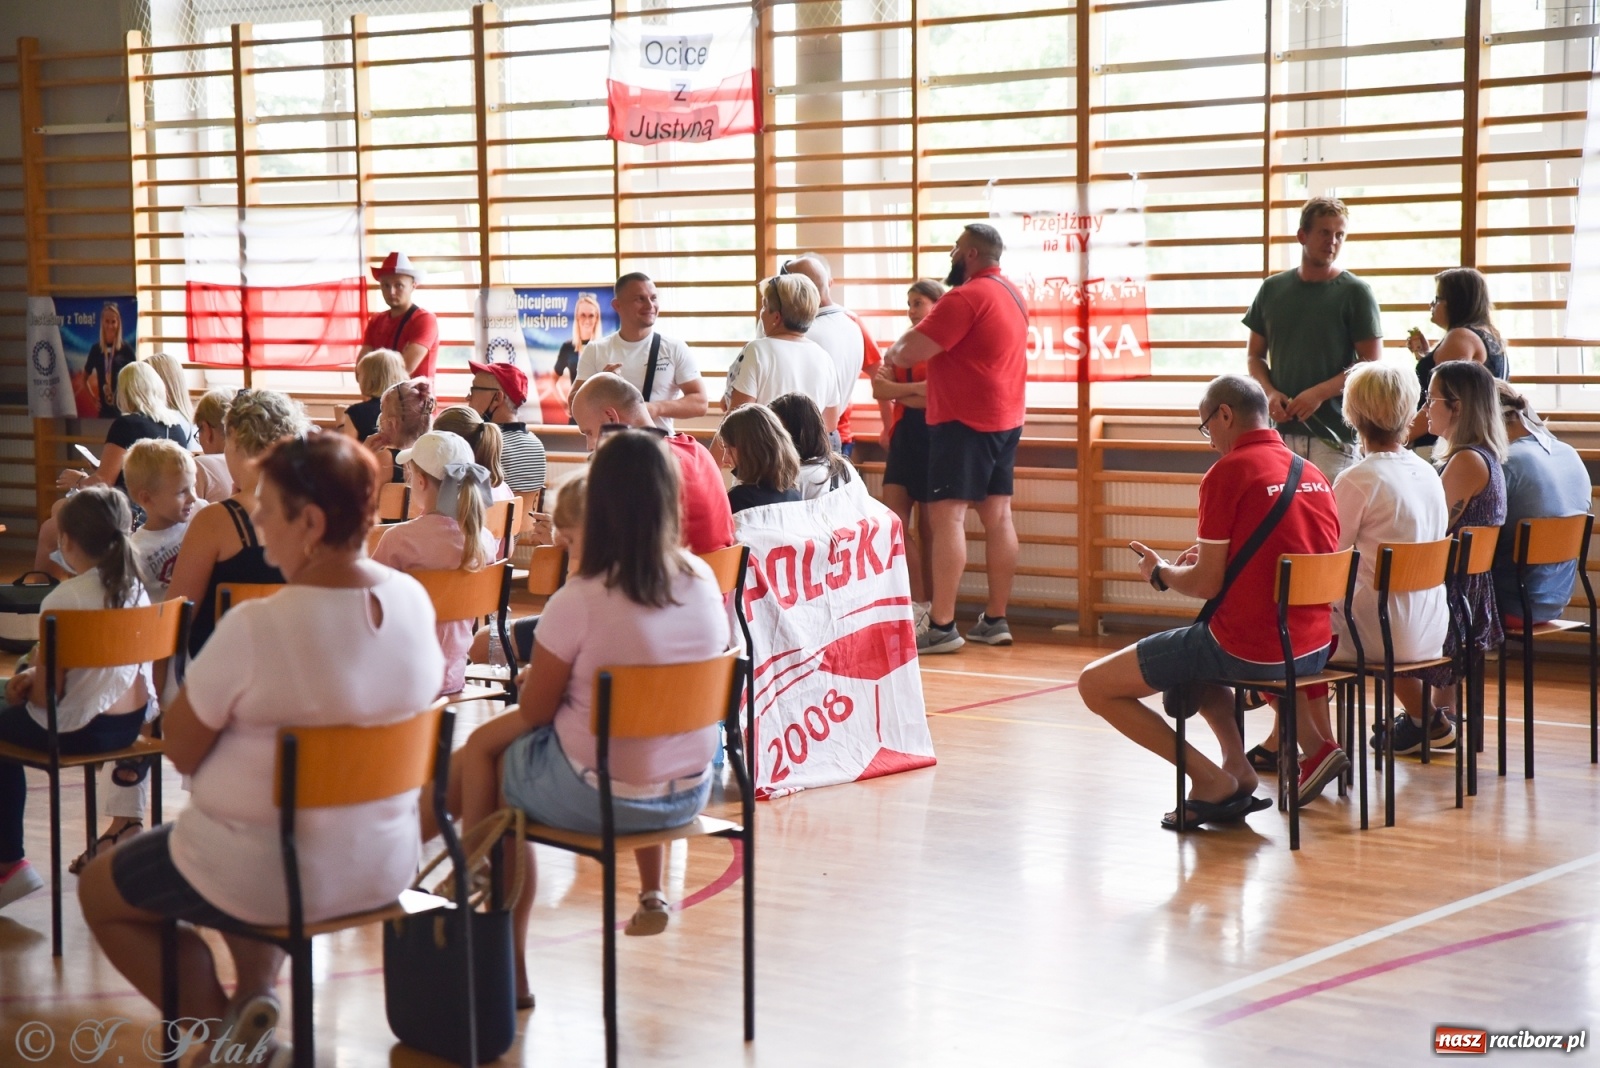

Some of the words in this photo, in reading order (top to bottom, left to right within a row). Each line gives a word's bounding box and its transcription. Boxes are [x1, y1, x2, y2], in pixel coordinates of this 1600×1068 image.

[645, 40, 707, 65] Ocice
[630, 115, 714, 141] Justyną
[1022, 212, 1104, 234] Przejdźmy
[1043, 239, 1058, 251] na
[1061, 232, 1090, 253] TY
[506, 294, 568, 312] Kibicujemy
[67, 315, 73, 325] z
[74, 312, 96, 327] Tobą!
[482, 313, 517, 331] naszej
[521, 313, 568, 331] Justynie
[1026, 324, 1145, 361] OLSKA
[768, 688, 854, 783] 2008
